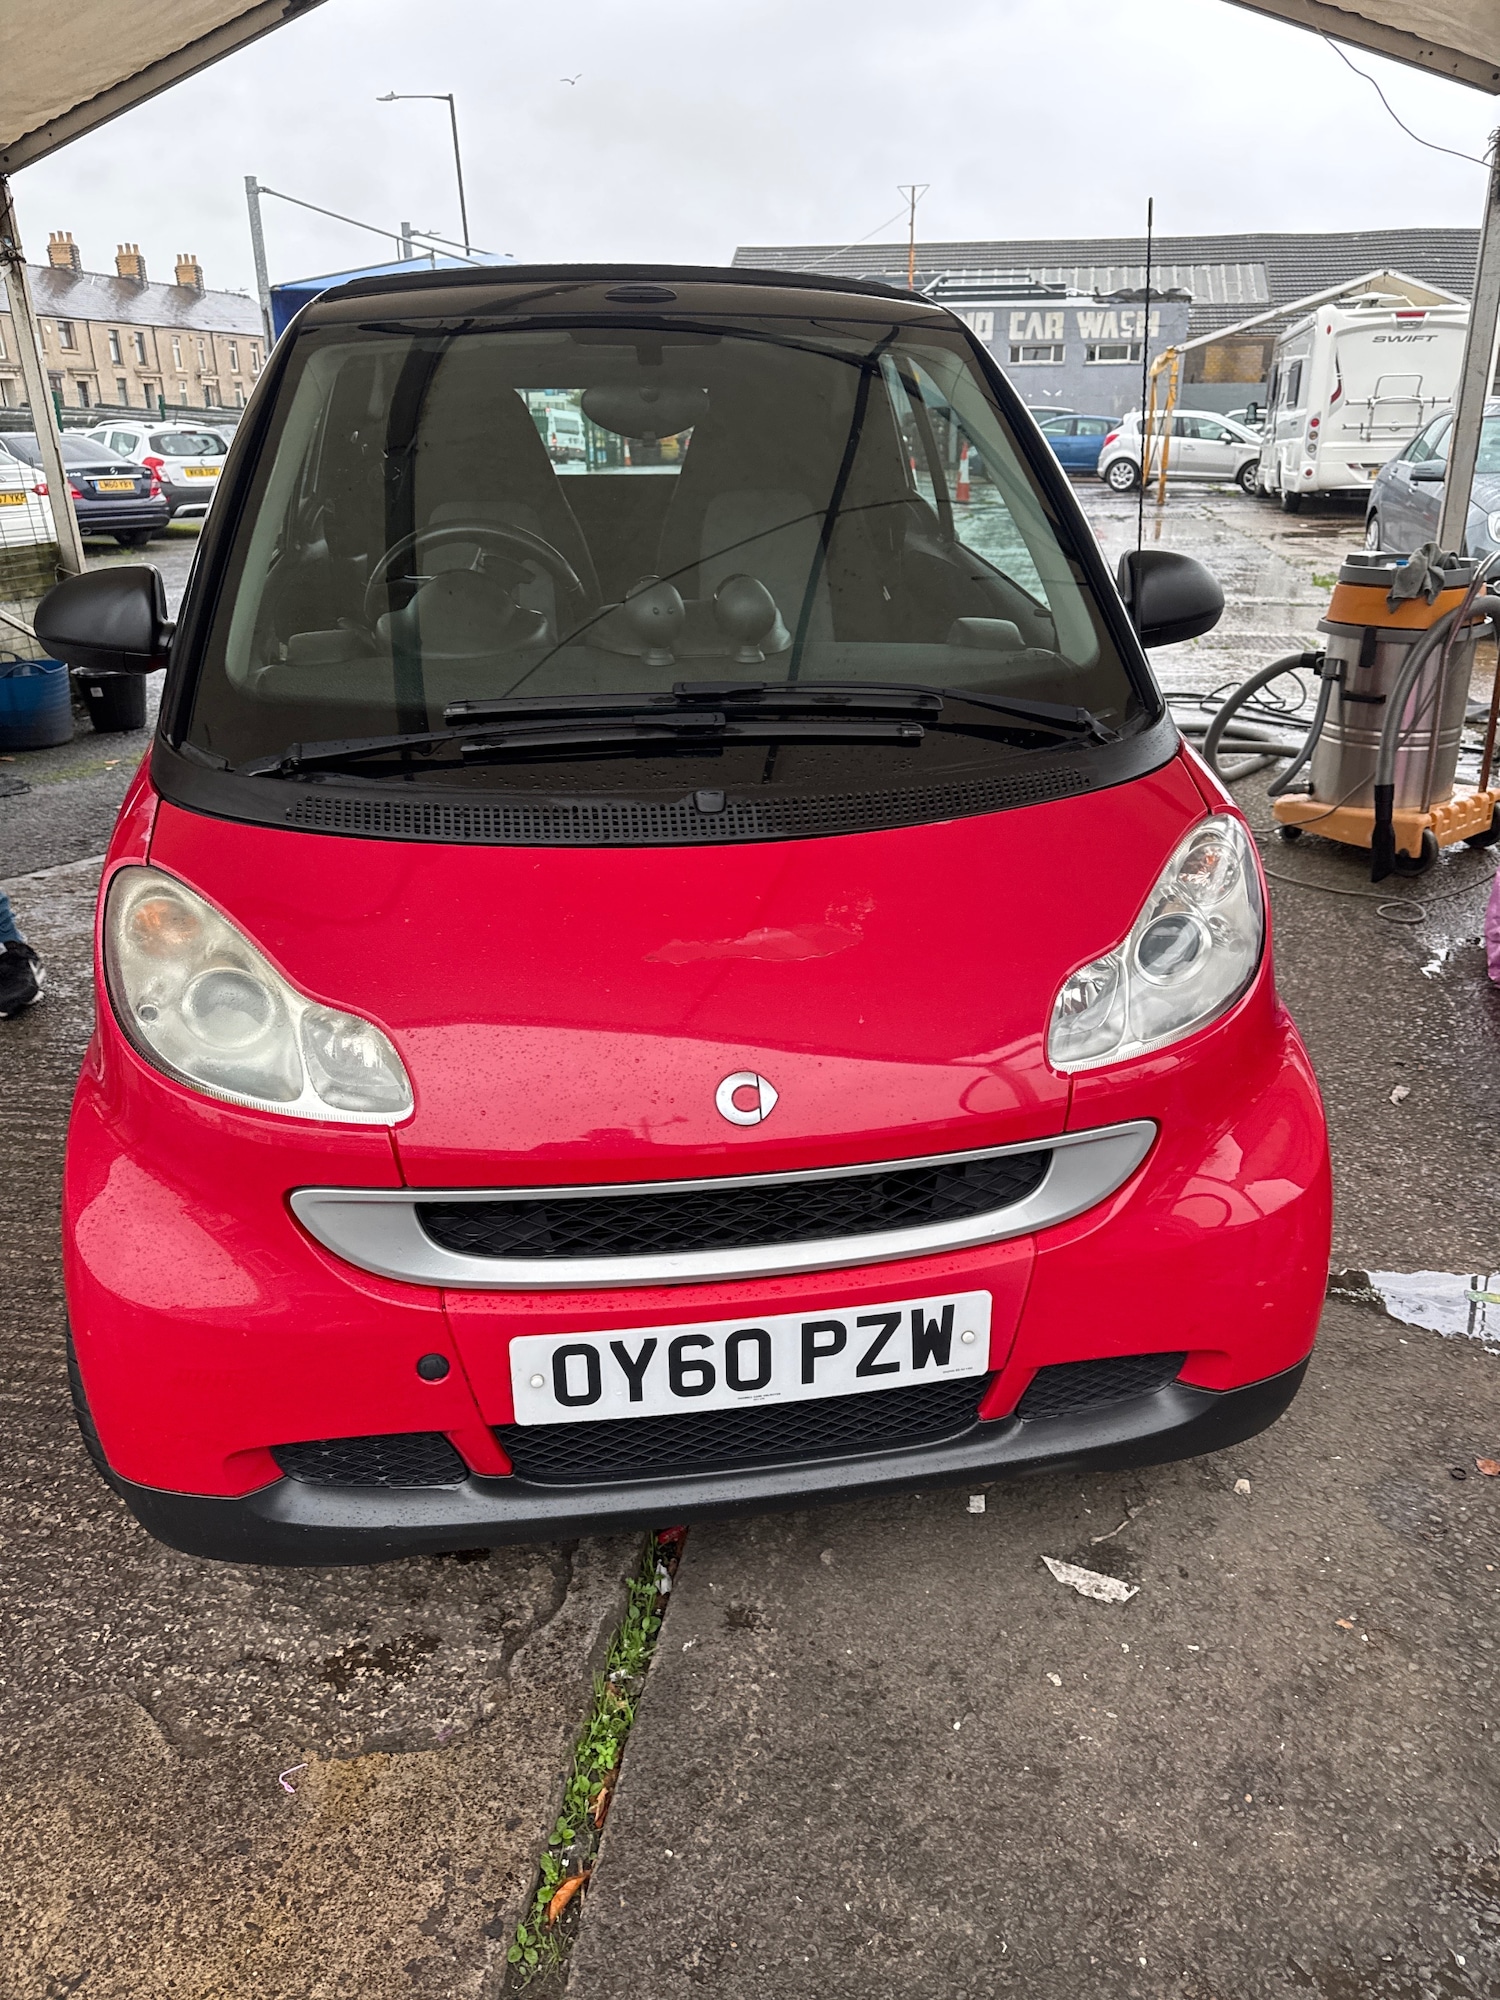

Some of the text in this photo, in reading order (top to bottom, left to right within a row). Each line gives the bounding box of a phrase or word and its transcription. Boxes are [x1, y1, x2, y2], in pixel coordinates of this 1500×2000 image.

[1008, 311, 1065, 341] CAR
[1076, 310, 1161, 339] WASH
[1372, 334, 1439, 343] SWIFT
[551, 1303, 955, 1407] OY60 PZW
